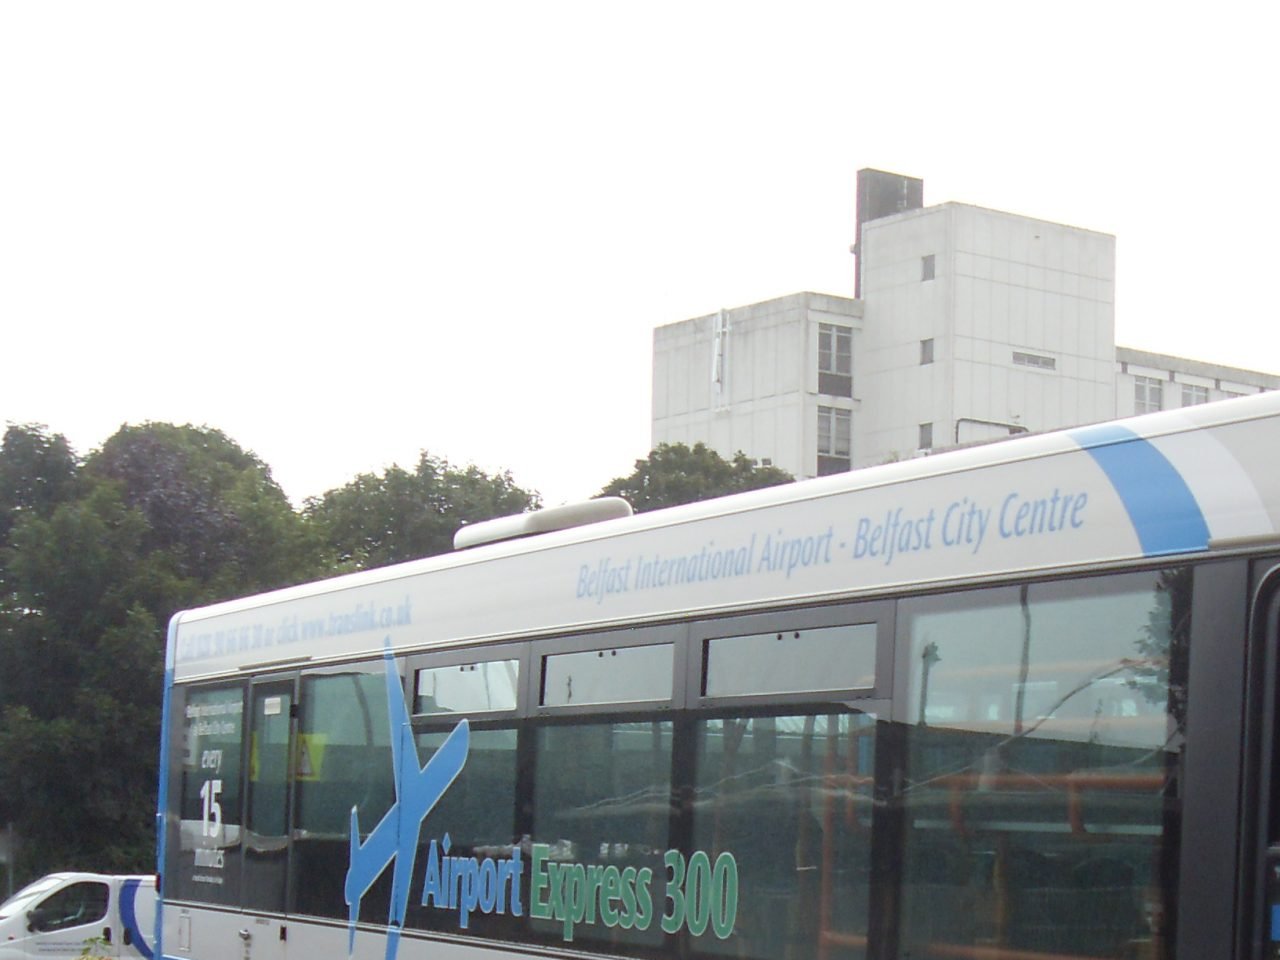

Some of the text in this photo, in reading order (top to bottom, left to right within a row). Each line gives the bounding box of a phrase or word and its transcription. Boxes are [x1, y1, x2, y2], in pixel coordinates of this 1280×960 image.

[576, 557, 632, 604] Belfast
[635, 539, 753, 589] International
[759, 526, 834, 578] Airport
[854, 507, 935, 564] Belfast
[941, 497, 992, 553] City
[998, 488, 1089, 538] Centre
[202, 749, 223, 774] every
[200, 780, 223, 838] 15
[421, 832, 738, 941] Airport Express 300
